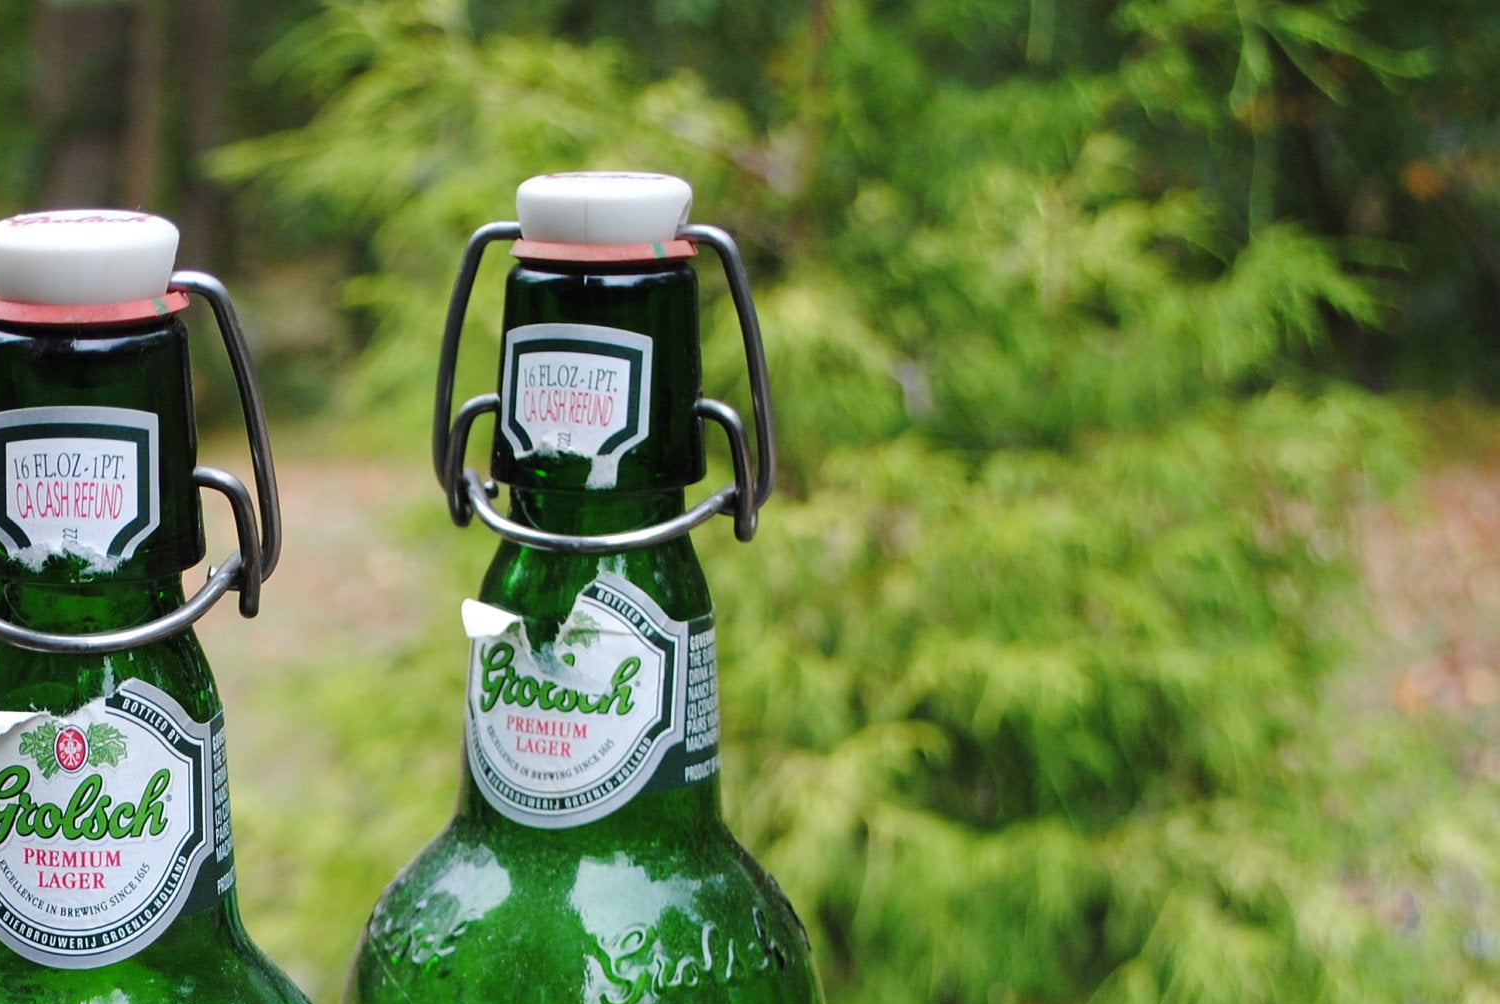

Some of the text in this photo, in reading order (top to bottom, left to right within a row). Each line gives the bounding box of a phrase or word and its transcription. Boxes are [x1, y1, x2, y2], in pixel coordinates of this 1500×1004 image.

[523, 368, 536, 388] 16
[523, 390, 614, 427] CA CASH REFUND
[12, 456, 30, 480] 16
[16, 481, 124, 520] CA CASH REFUND
[596, 588, 641, 624] BOTTLED
[121, 698, 181, 745] BOTTLED BY
[506, 714, 588, 739] PREMIUM
[516, 736, 572, 757] LAGER
[531, 768, 573, 781] BREWING
[573, 752, 600, 775] SINCE
[23, 847, 122, 868] PREMIUM
[37, 870, 107, 890] LAGER
[46, 903, 58, 916] IN
[60, 901, 109, 918] BREWING
[110, 880, 137, 907] SINCE
[133, 861, 151, 884] 1615
[2, 910, 98, 950] BIERBROUWERIJ
